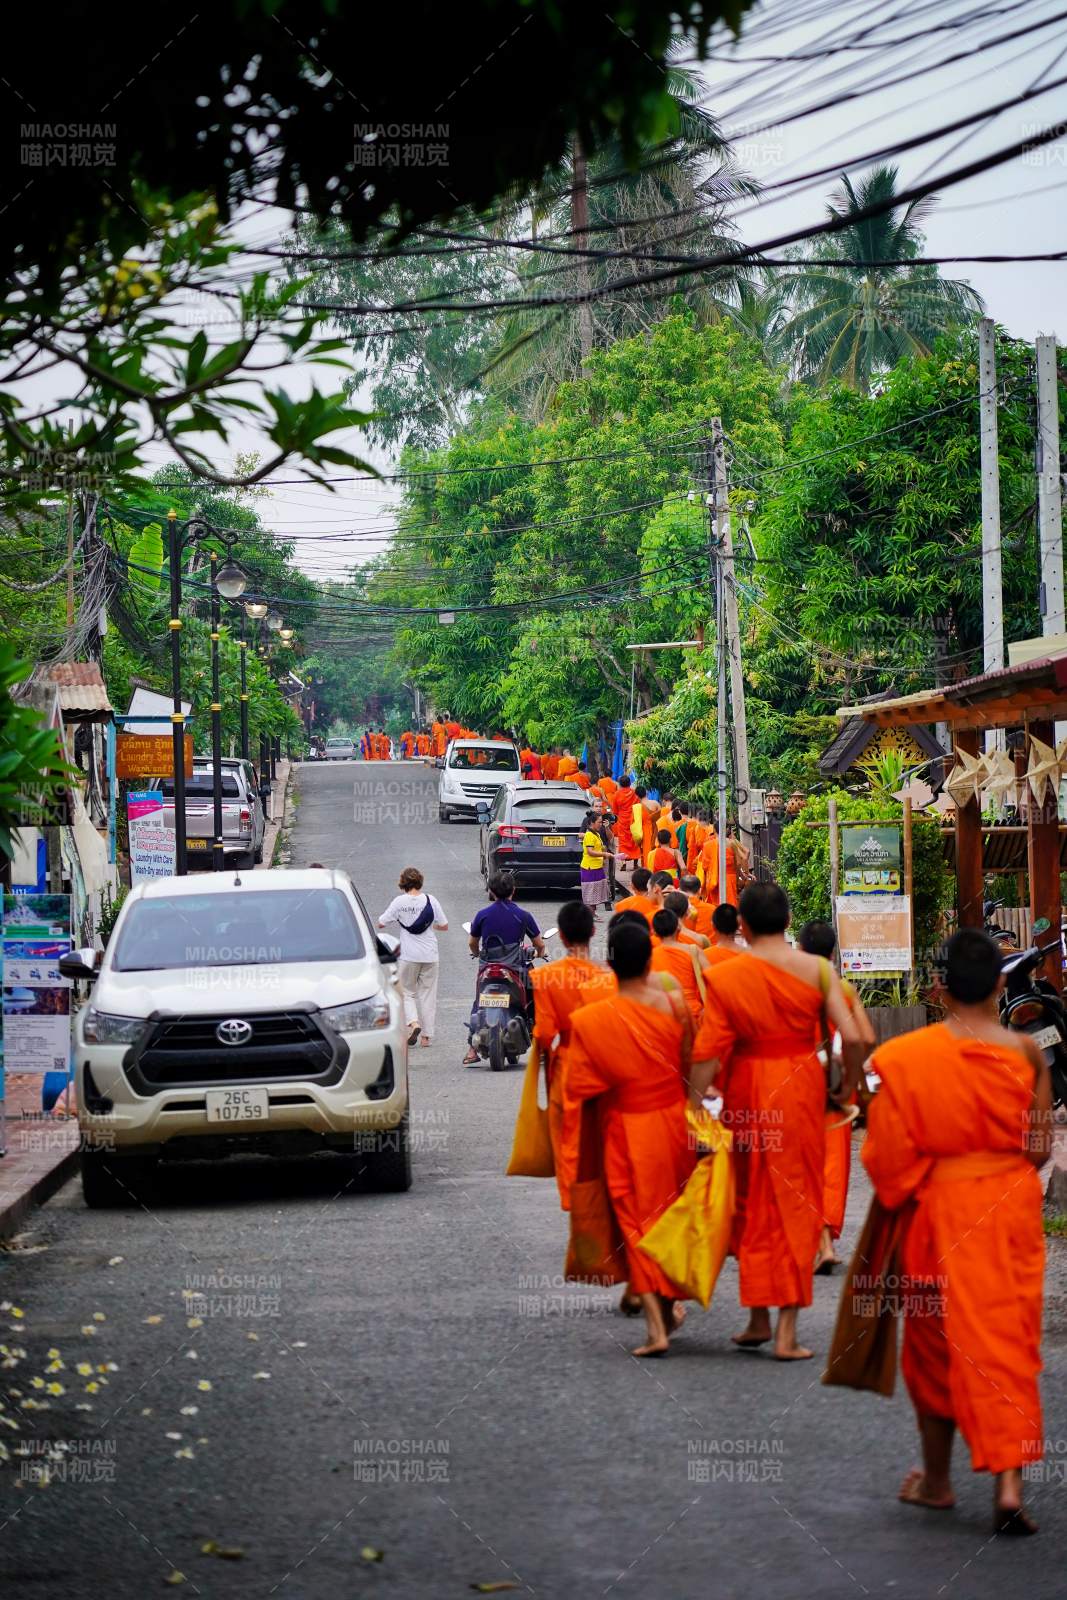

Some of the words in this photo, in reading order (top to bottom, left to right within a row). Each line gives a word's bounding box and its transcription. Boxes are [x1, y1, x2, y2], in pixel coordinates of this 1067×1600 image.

[120, 751, 153, 764] Laundry
[128, 765, 150, 773] Wash
[135, 853, 152, 864] Laundry
[152, 854, 162, 862] With
[162, 855, 173, 864] Care
[155, 866, 164, 875] and
[863, 951, 873, 959] Pay
[224, 1091, 250, 1105] 26C
[215, 1105, 262, 1120] 107.59
